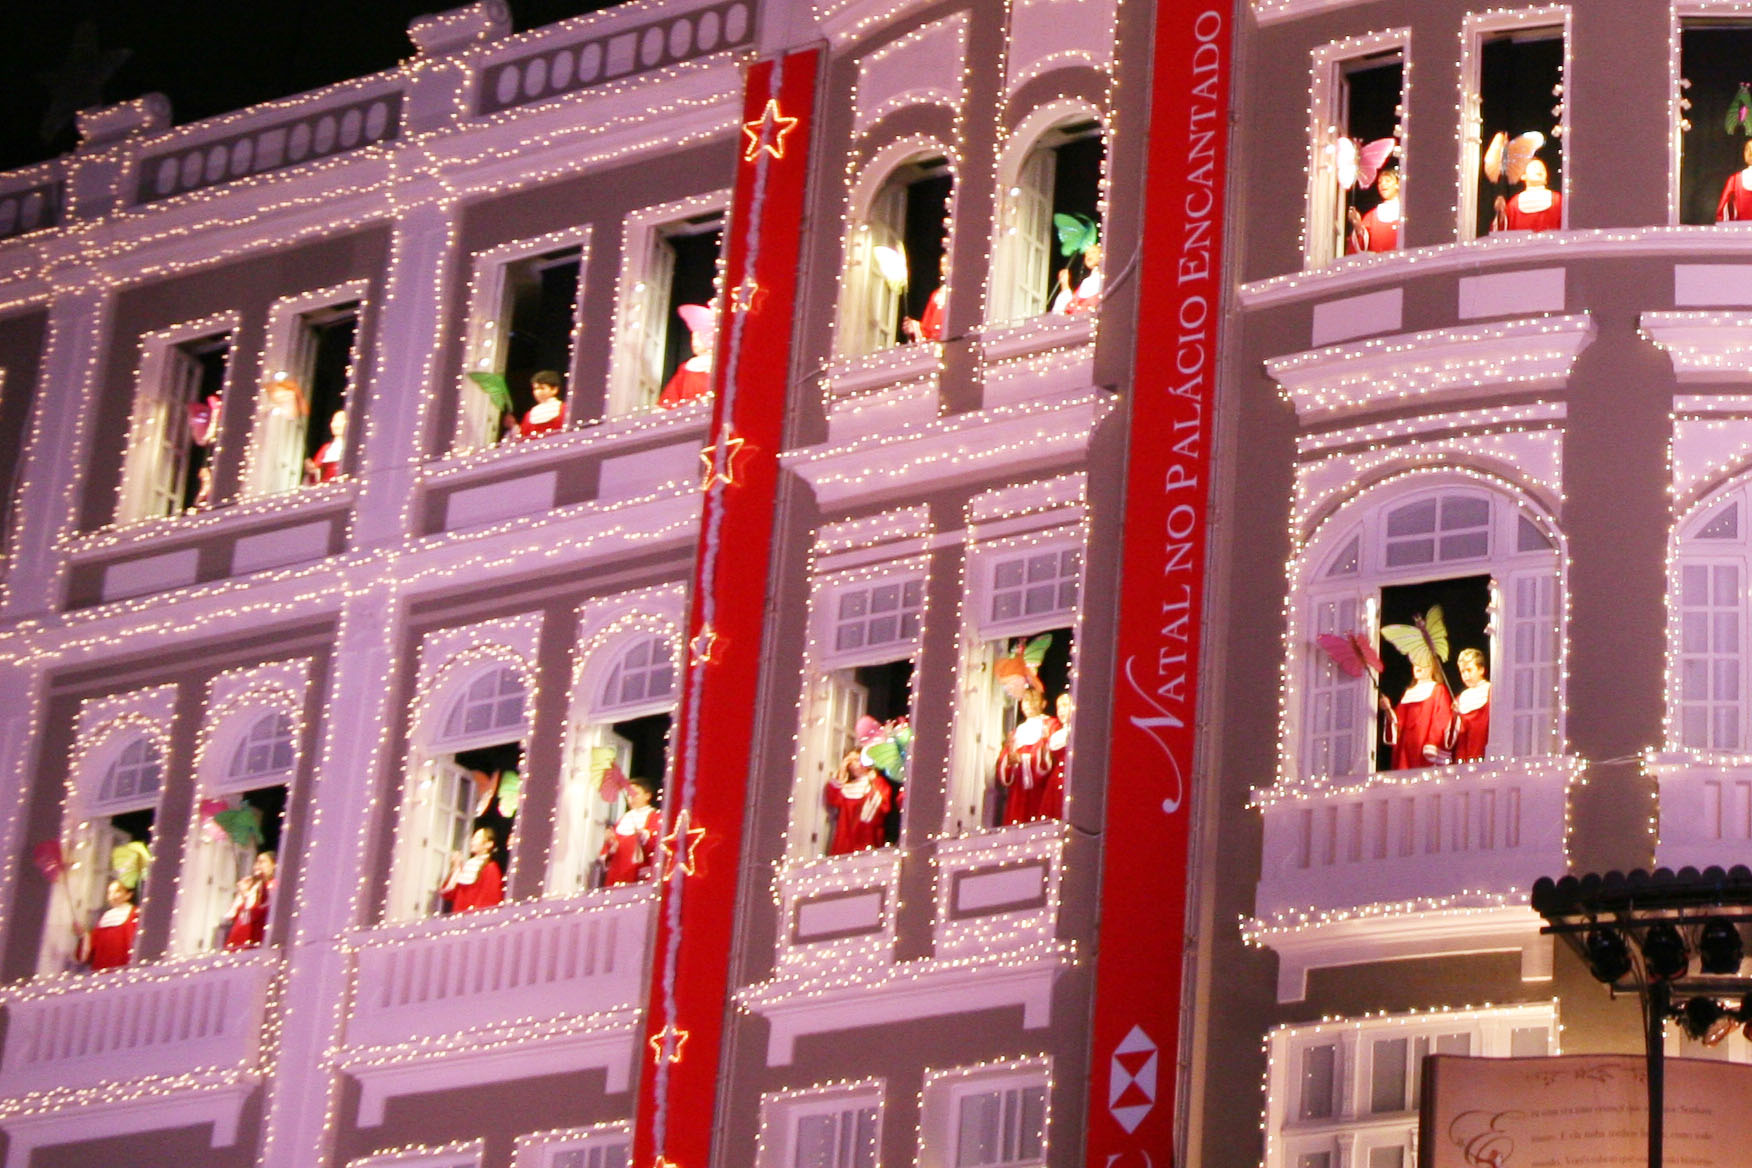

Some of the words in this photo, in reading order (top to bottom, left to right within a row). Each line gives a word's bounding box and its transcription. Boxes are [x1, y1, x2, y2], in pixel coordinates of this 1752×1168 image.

[1177, 10, 1221, 286] ENCANTADO
[1165, 295, 1208, 493] PALÁCIO
[1165, 504, 1196, 575] NO
[1125, 584, 1192, 814] NATAL
